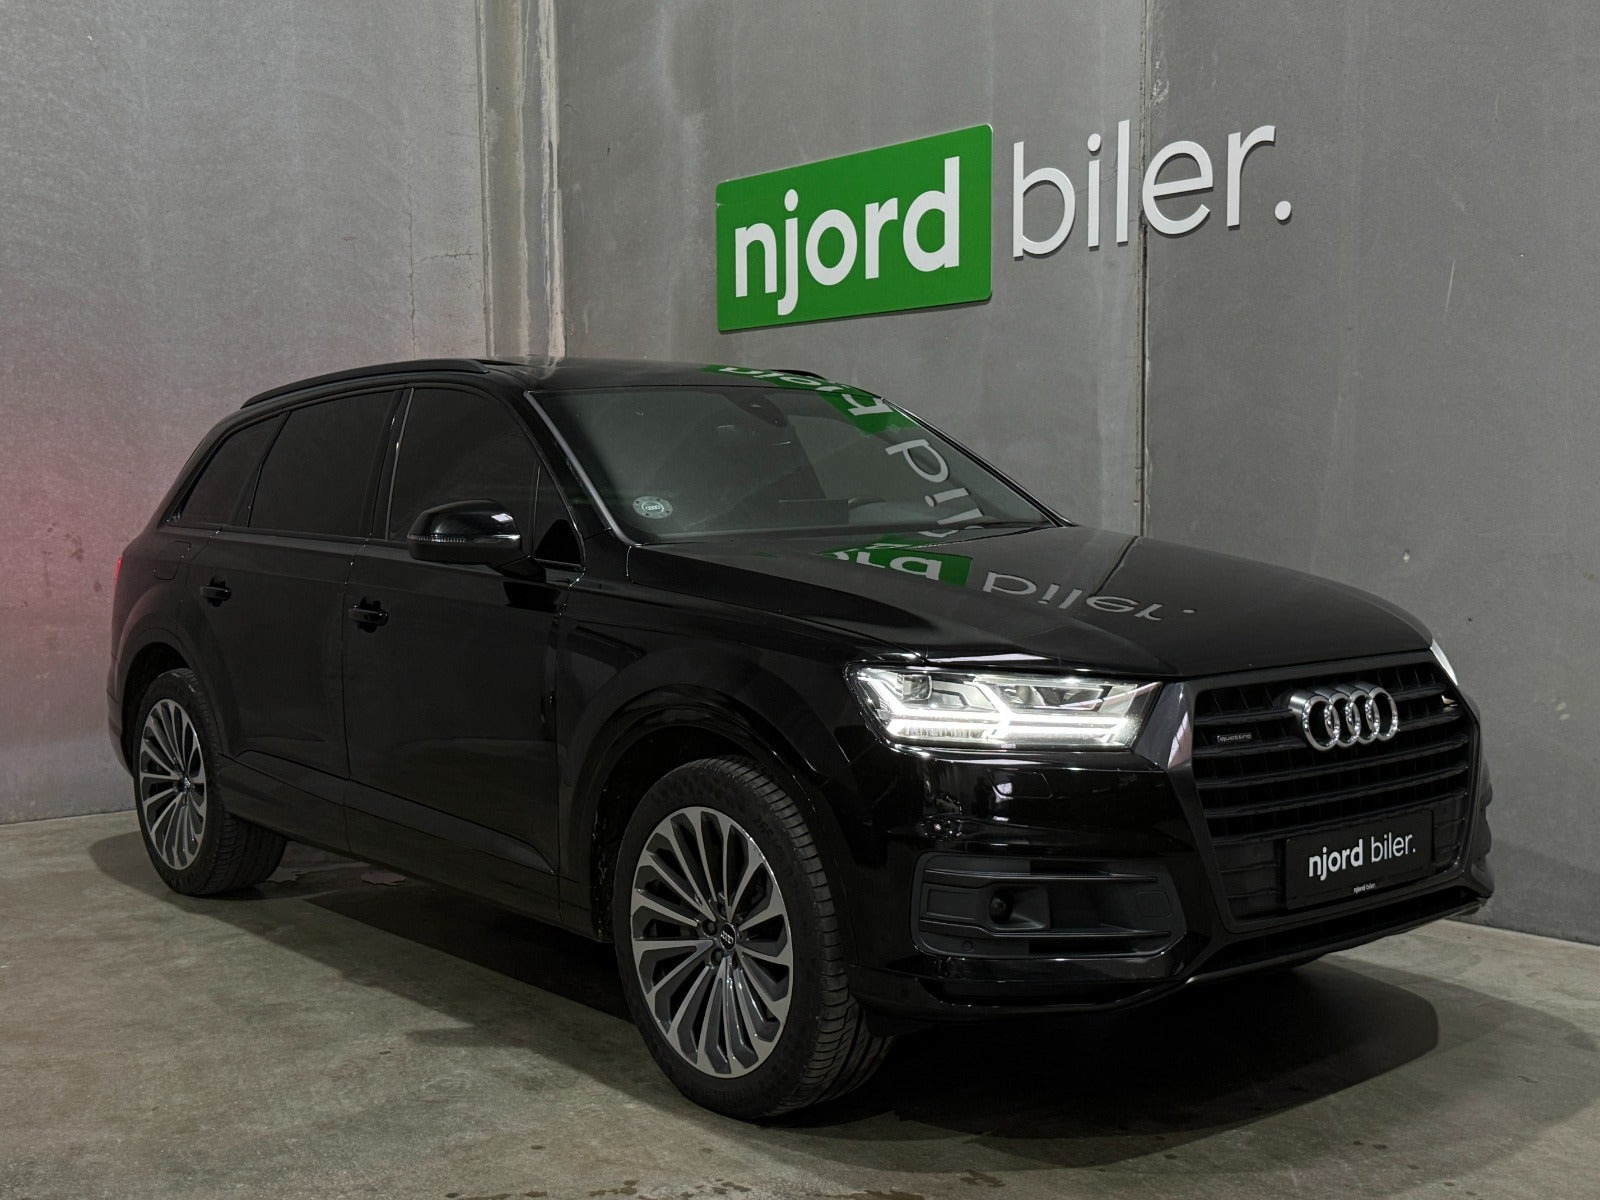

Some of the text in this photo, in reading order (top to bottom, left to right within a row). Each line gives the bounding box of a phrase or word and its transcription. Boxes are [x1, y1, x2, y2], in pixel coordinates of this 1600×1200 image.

[734, 119, 1293, 316] njord biler.
[1308, 831, 1416, 881] njord biler.
[1353, 884, 1366, 894] njord
